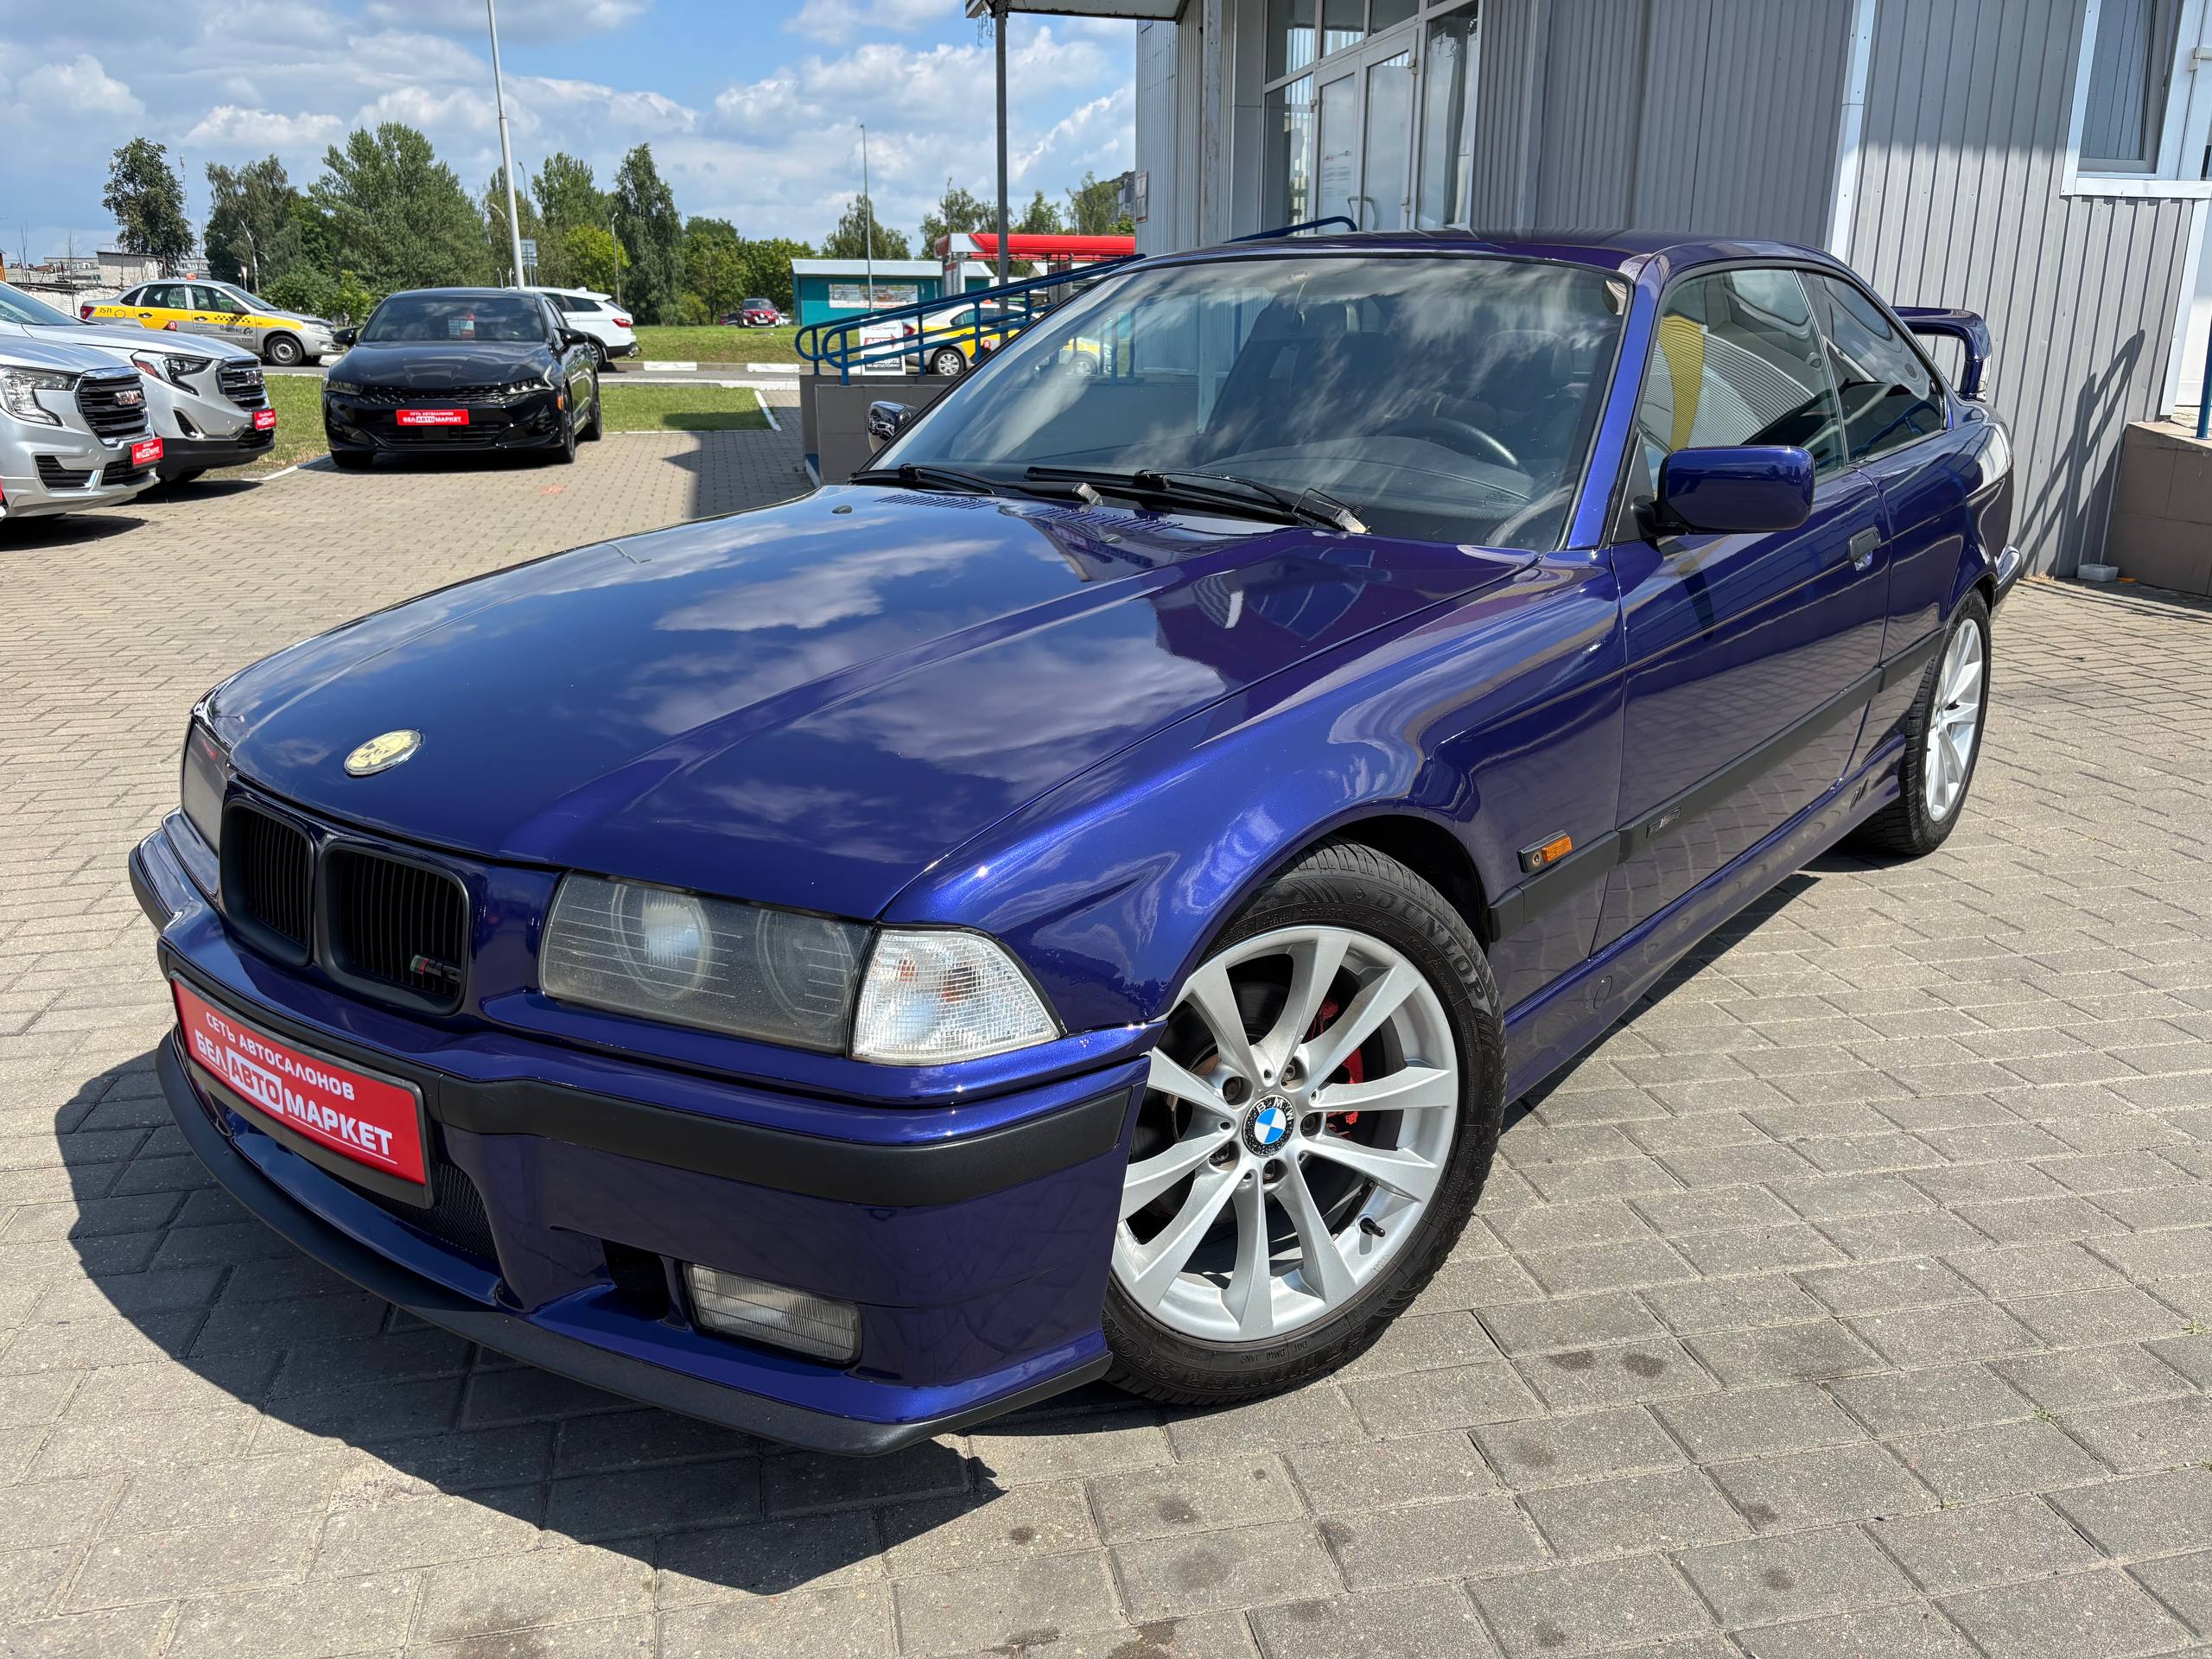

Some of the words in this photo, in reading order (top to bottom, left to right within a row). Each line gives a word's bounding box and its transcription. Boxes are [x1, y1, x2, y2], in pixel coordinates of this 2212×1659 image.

[1370, 889, 1485, 1001] DUNLOP
[206, 1011, 236, 1044] СЕТЬ
[239, 1033, 355, 1101] АВТОСАЛОНОВ
[1255, 1096, 1294, 1121] BMW
